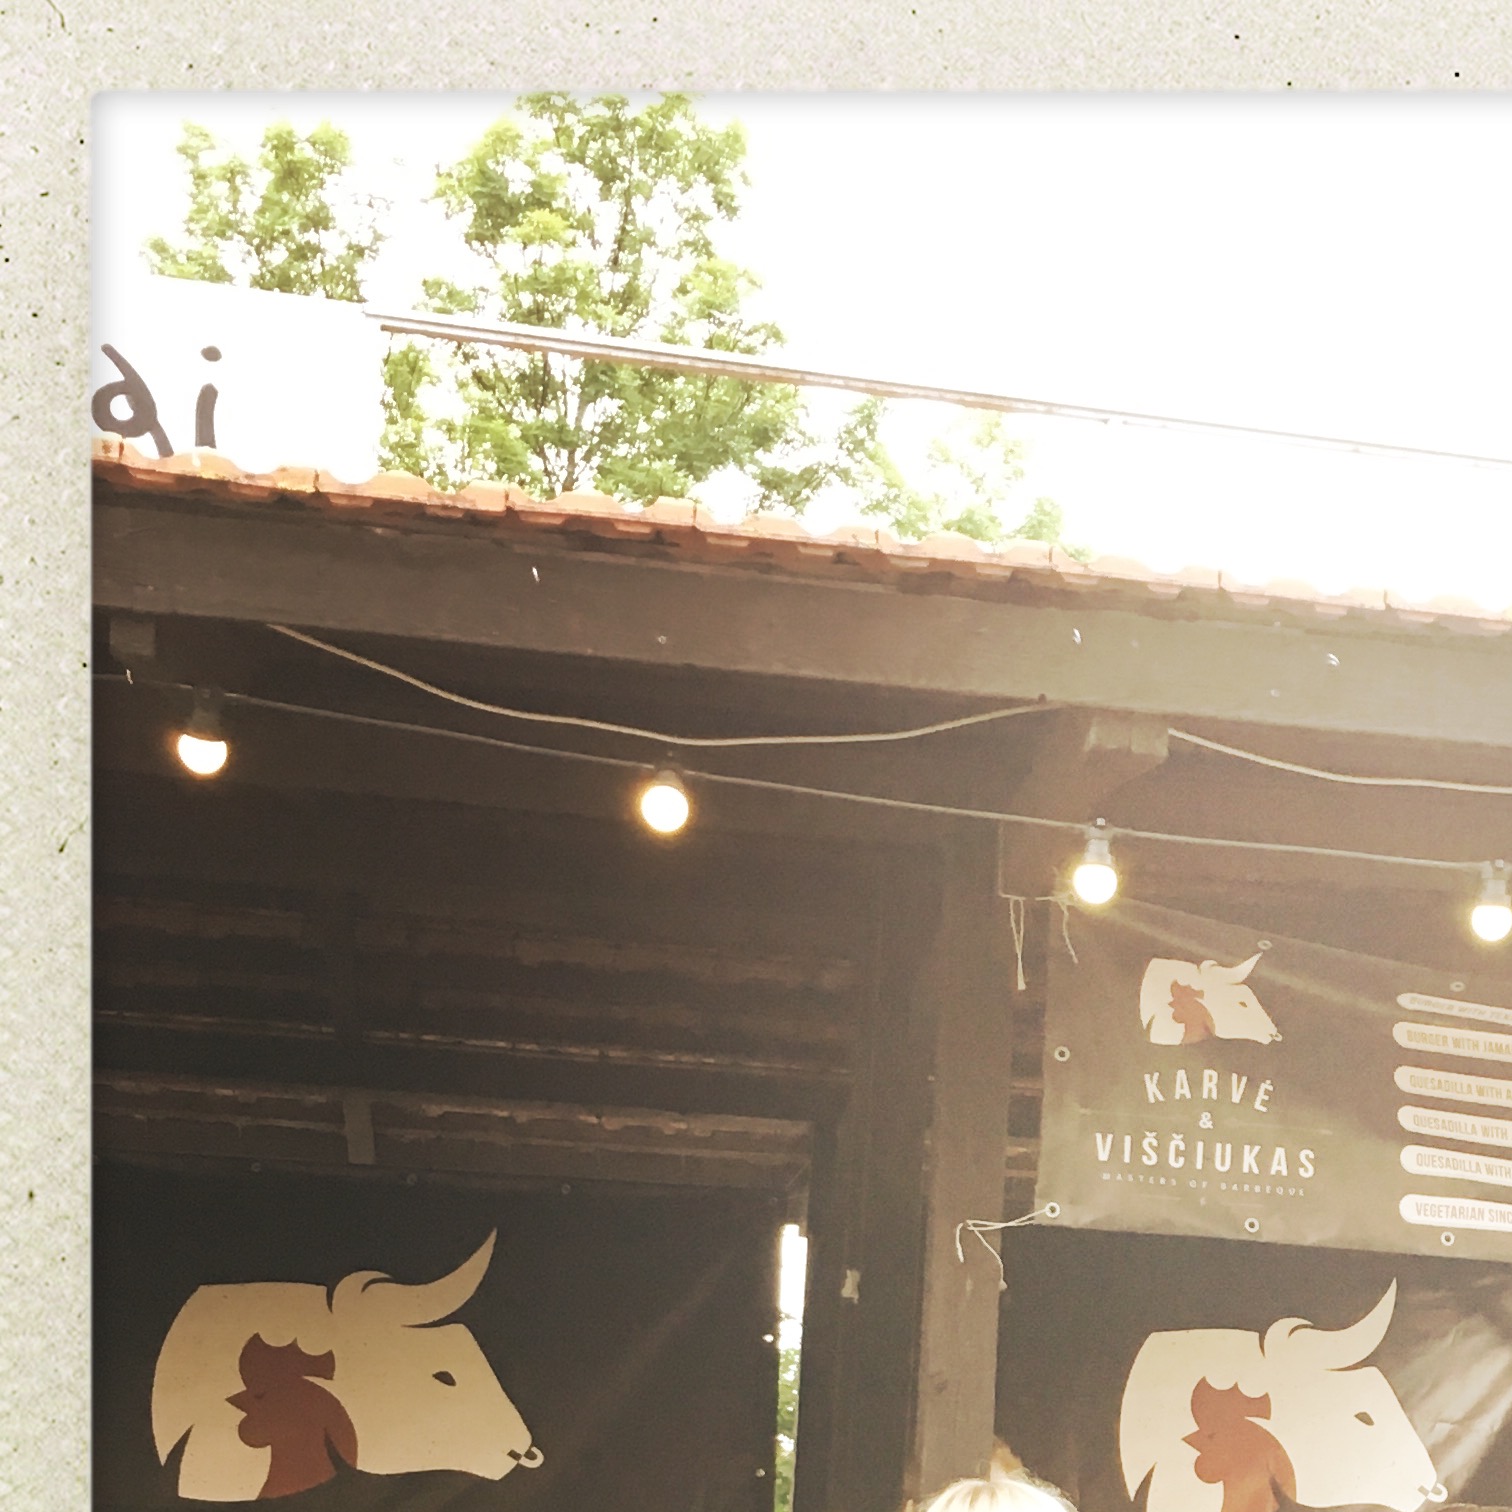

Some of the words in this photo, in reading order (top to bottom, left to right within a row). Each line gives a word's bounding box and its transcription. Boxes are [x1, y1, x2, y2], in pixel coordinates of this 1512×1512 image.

[1406, 1030, 1450, 1047] BURGER
[1452, 1036, 1480, 1051] WITH
[1144, 1069, 1274, 1112] KARVĖ
[1409, 1074, 1473, 1095] QUESADILLA
[1475, 1084, 1503, 1100] WITH
[1199, 1111, 1213, 1129] &
[1413, 1114, 1478, 1137] QUESADILLA
[1481, 1124, 1508, 1140] WITH
[1095, 1131, 1315, 1178] VIŠČIUKAS
[1416, 1152, 1482, 1175] QUESADILLA
[1485, 1163, 1512, 1179] WITH
[1415, 1201, 1485, 1222] VEGETARIAN
